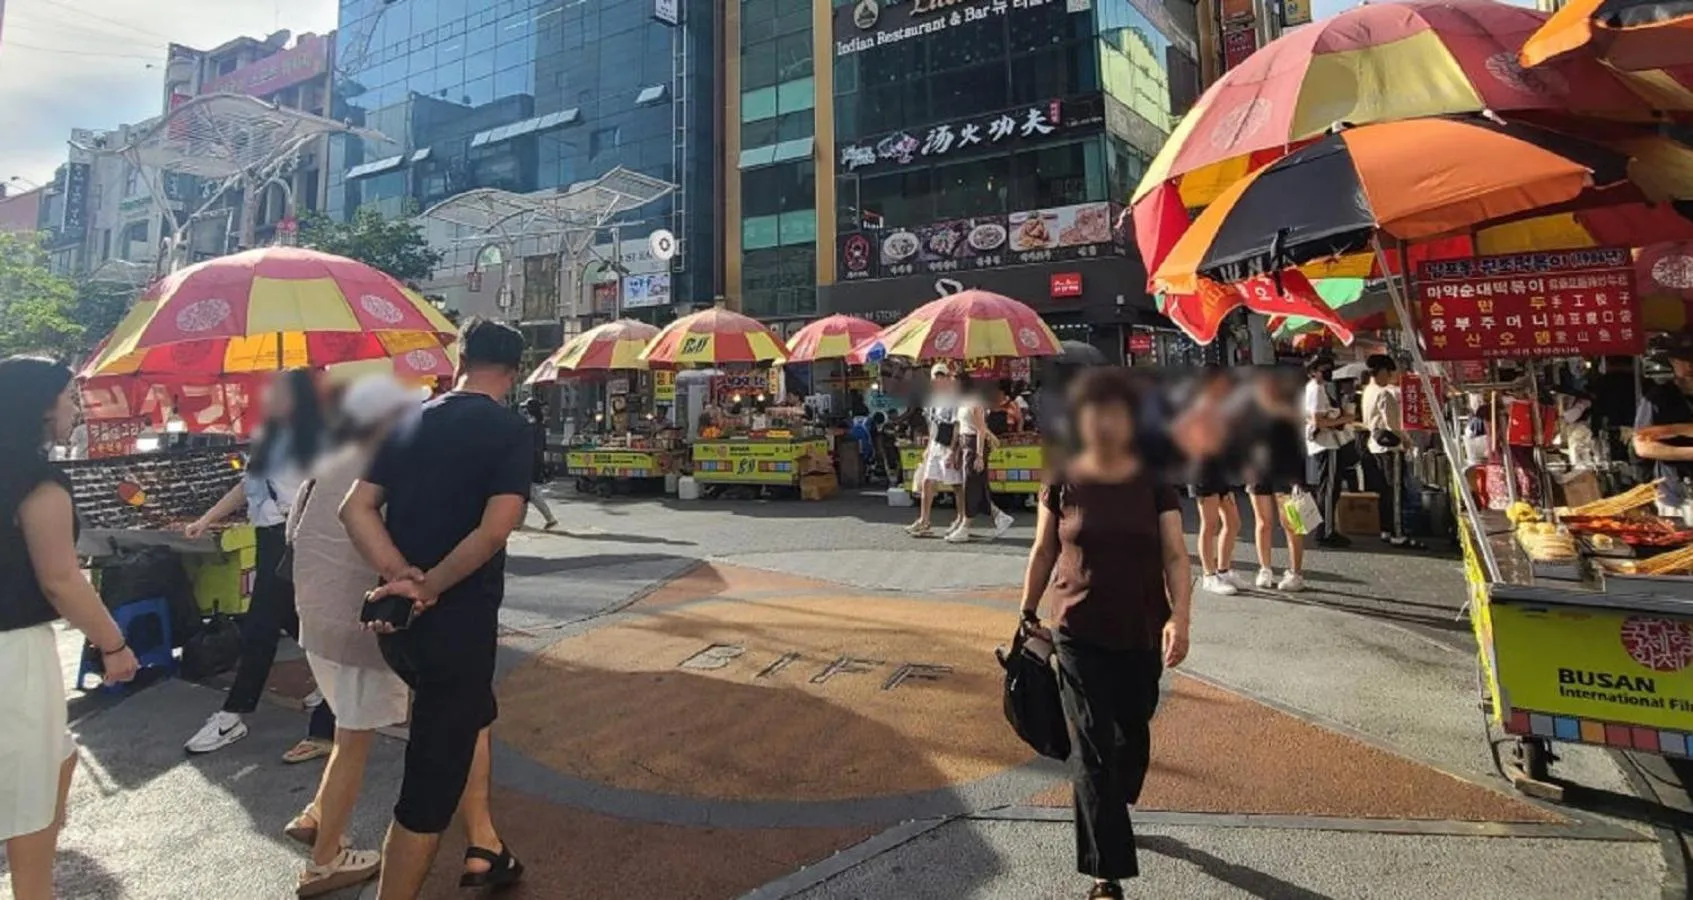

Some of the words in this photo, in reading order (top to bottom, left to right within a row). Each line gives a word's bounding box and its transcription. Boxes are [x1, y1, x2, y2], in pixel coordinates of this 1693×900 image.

[836, 36, 874, 56] Indian
[877, 17, 947, 45] Restaurant
[949, 11, 961, 26] &
[964, 7, 989, 23] Bar
[1427, 278, 1545, 299] 마약순대떡볶이
[677, 642, 953, 691] BIFF
[1557, 667, 1656, 693] BUSAN
[1559, 686, 1664, 709] International
